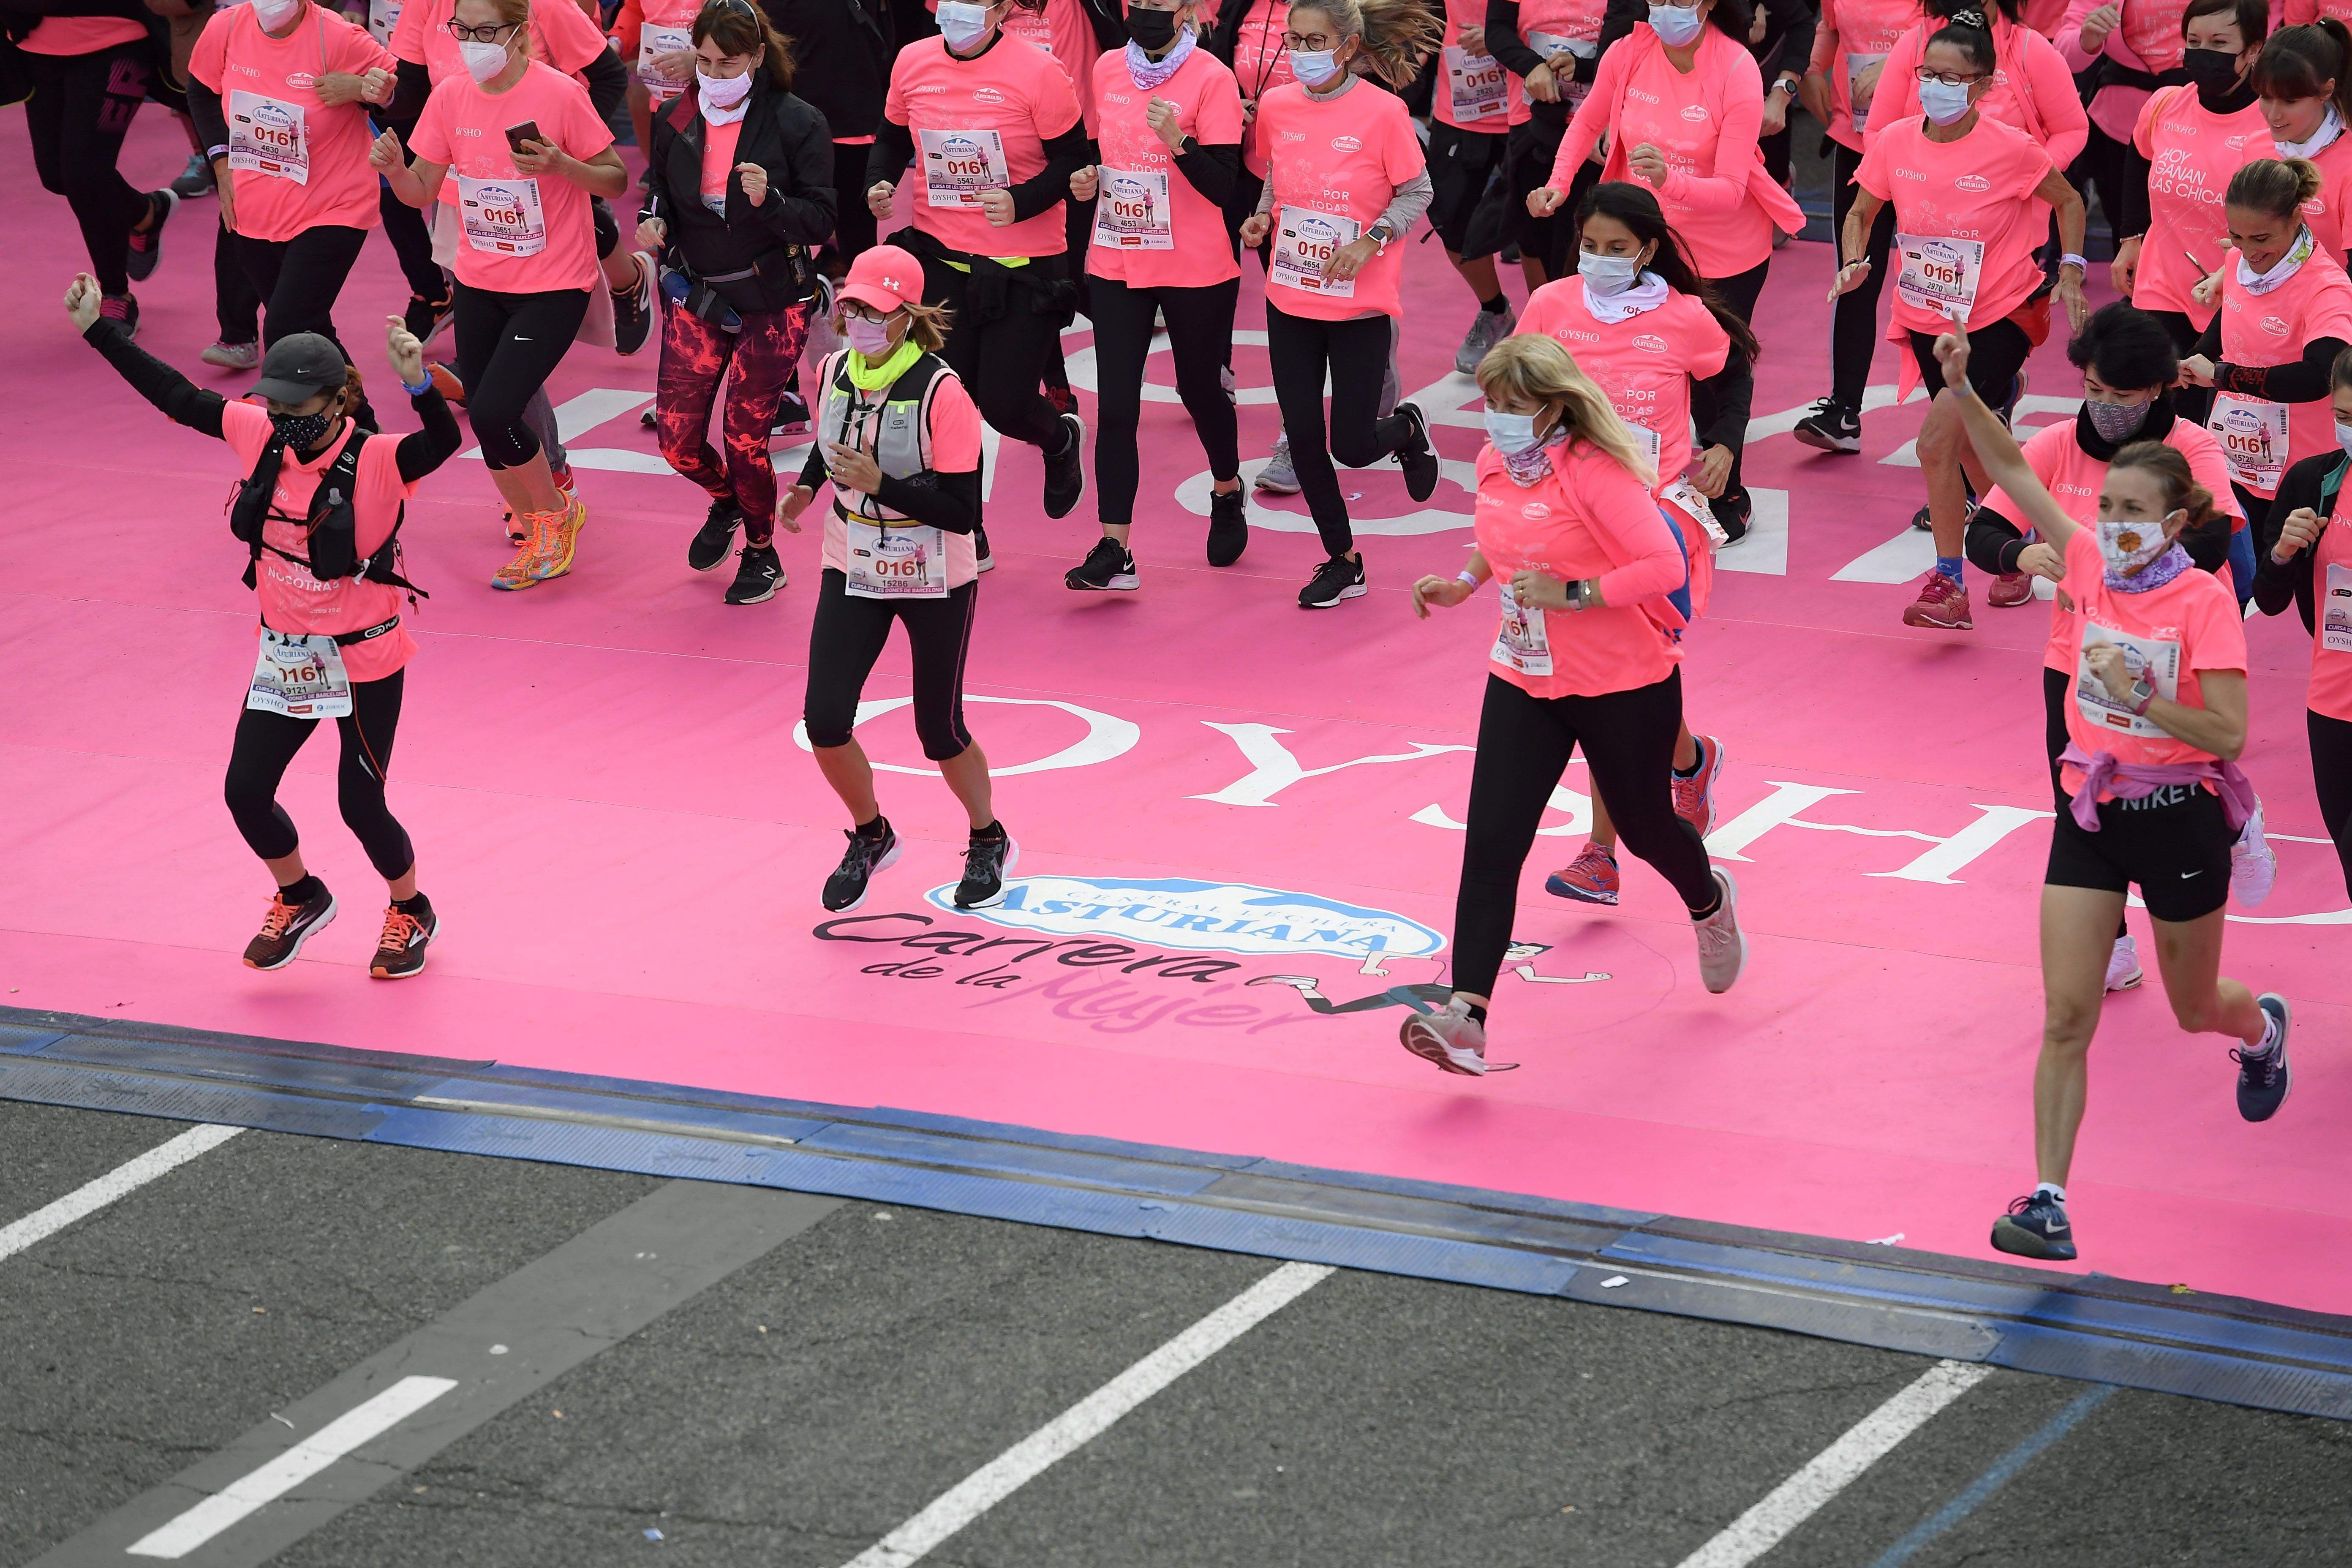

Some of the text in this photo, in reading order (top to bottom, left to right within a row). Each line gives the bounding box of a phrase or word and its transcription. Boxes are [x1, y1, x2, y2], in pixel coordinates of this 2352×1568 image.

[1027, 18, 1050, 26] POR
[1015, 27, 1051, 38] TODAS
[1467, 71, 1499, 87] 016
[975, 92, 1002, 101] ASTURIANA
[1105, 93, 1130, 104] OYSHO
[1628, 87, 1660, 105] OYSHO
[256, 110, 289, 125] ASTURIANA
[456, 127, 482, 137] OYSHO
[2163, 122, 2197, 135] OYSHO
[255, 126, 289, 146] 016
[1281, 131, 1306, 142] OYSHO
[261, 145, 279, 154] 4630
[232, 157, 256, 165] OYSHO
[284, 156, 307, 168] BARCELONA
[1142, 152, 1168, 163] POR
[1670, 152, 1695, 164] POR
[2159, 148, 2193, 165] HOY
[948, 161, 980, 174] 016
[2155, 160, 2207, 186] GANAN
[1895, 168, 1926, 182] OYSHO
[1113, 184, 1142, 194] ASTURIANA
[1958, 180, 1987, 188] ASTURIANA
[1323, 190, 1349, 201] POR
[2150, 174, 2227, 207] LAS CHICA
[480, 193, 512, 202] ASTURIANA
[1114, 201, 1143, 218] 016
[1310, 200, 1349, 212] TODAS
[484, 208, 516, 224] 016
[493, 226, 511, 234] 10651
[1300, 223, 1332, 237] ASTURIANA
[1952, 229, 1979, 238] POR
[472, 238, 494, 248] OYSHO
[1098, 233, 1118, 242] OYSHO
[1298, 241, 1330, 260] 016
[1303, 259, 1320, 269] 4654
[1276, 271, 1298, 282] OYSHO
[1924, 263, 1953, 283] 016
[1927, 282, 1943, 292] 2970
[1902, 292, 1923, 304] OYSHO
[1946, 296, 1971, 305] BARCELONA
[2224, 294, 2242, 313] OYSHO
[2262, 319, 2287, 333] ASTURIANA
[1559, 329, 1600, 343] OYSHO
[1635, 339, 1665, 351] ASTURIANA
[1627, 389, 1655, 401] POR
[1612, 403, 1653, 415] ODAS
[2227, 417, 2258, 428] ASTURIANA
[2227, 434, 2259, 453] 016
[876, 560, 915, 576] 016
[1523, 559, 1550, 570] POR
[255, 685, 274, 693] CURSA
[286, 686, 307, 694] 9121
[253, 696, 284, 709] OYSHO
[2121, 784, 2186, 811] NIKE
[993, 884, 1390, 951] ASTURIANA
[1067, 890, 1397, 933] CENTRAL LECHERA
[813, 912, 1244, 983] Carrera
[860, 956, 1022, 989] de la
[961, 965, 1348, 1035] Mujer
